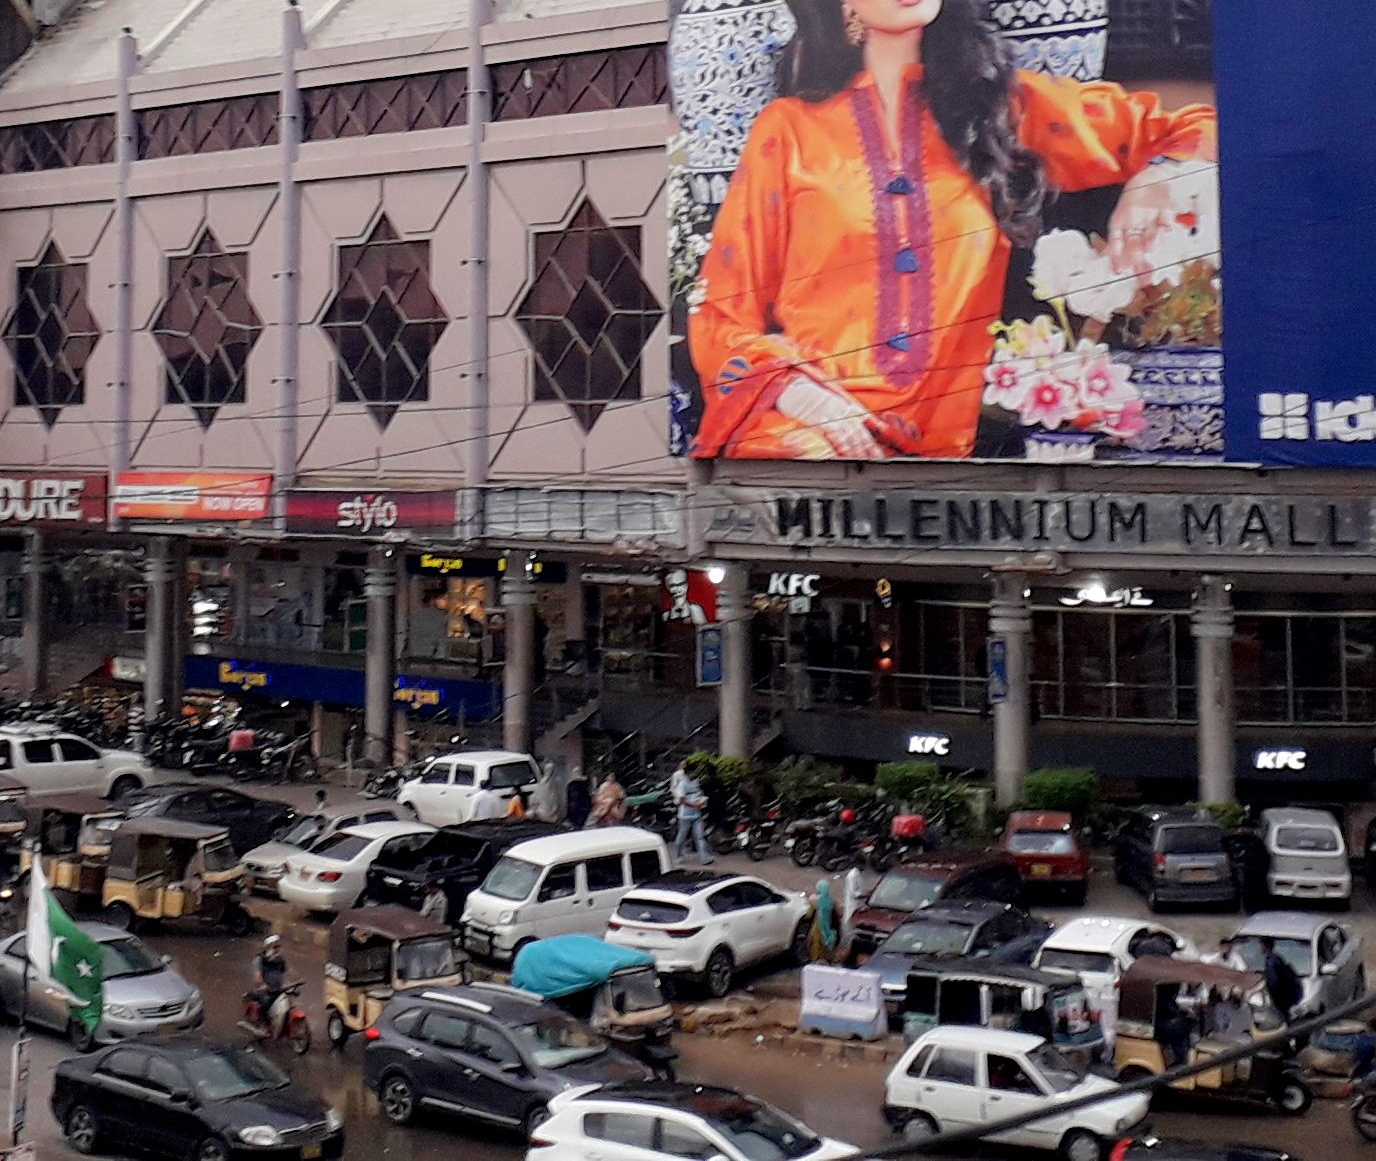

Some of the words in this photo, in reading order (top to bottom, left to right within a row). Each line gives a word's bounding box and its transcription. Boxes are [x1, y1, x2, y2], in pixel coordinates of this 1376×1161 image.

[775, 497, 1147, 544] MILLENNIUM
[1182, 503, 1357, 546] MALL
[768, 572, 821, 597] KFC
[907, 735, 951, 756] KFC
[1255, 750, 1307, 770] KFC
